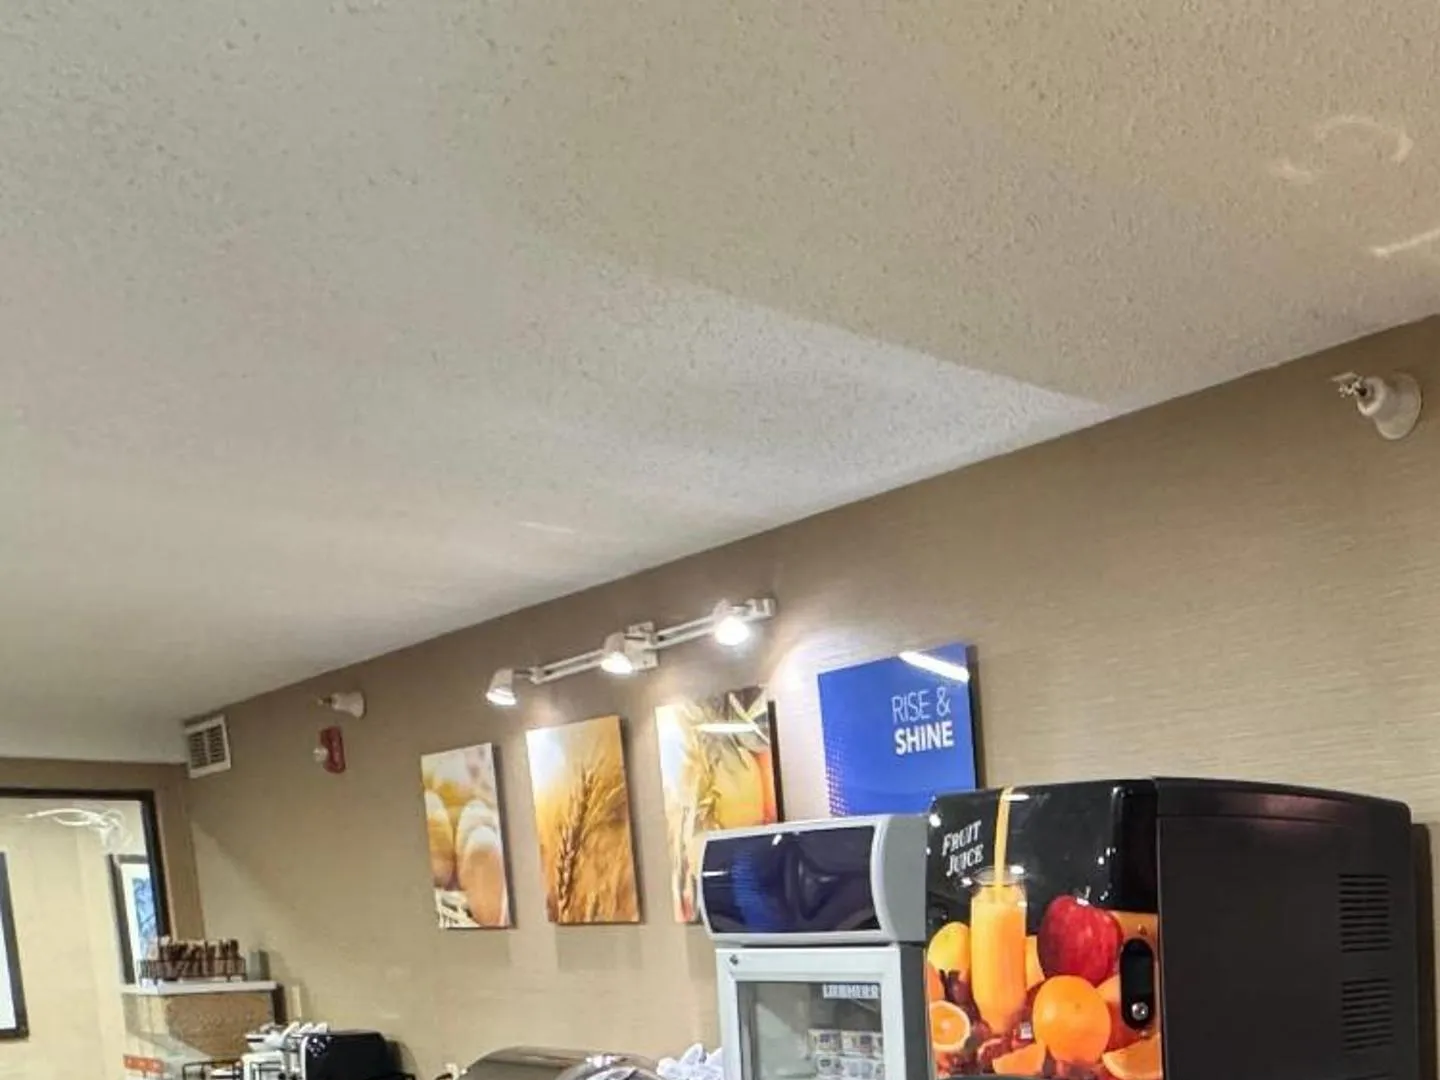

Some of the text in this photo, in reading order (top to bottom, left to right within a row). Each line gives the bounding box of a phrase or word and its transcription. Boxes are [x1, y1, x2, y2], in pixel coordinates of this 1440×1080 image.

[891, 686, 951, 724] RISE &
[894, 720, 954, 756] SHINE
[942, 820, 982, 857] FRUIT
[946, 843, 984, 877] JUICE
